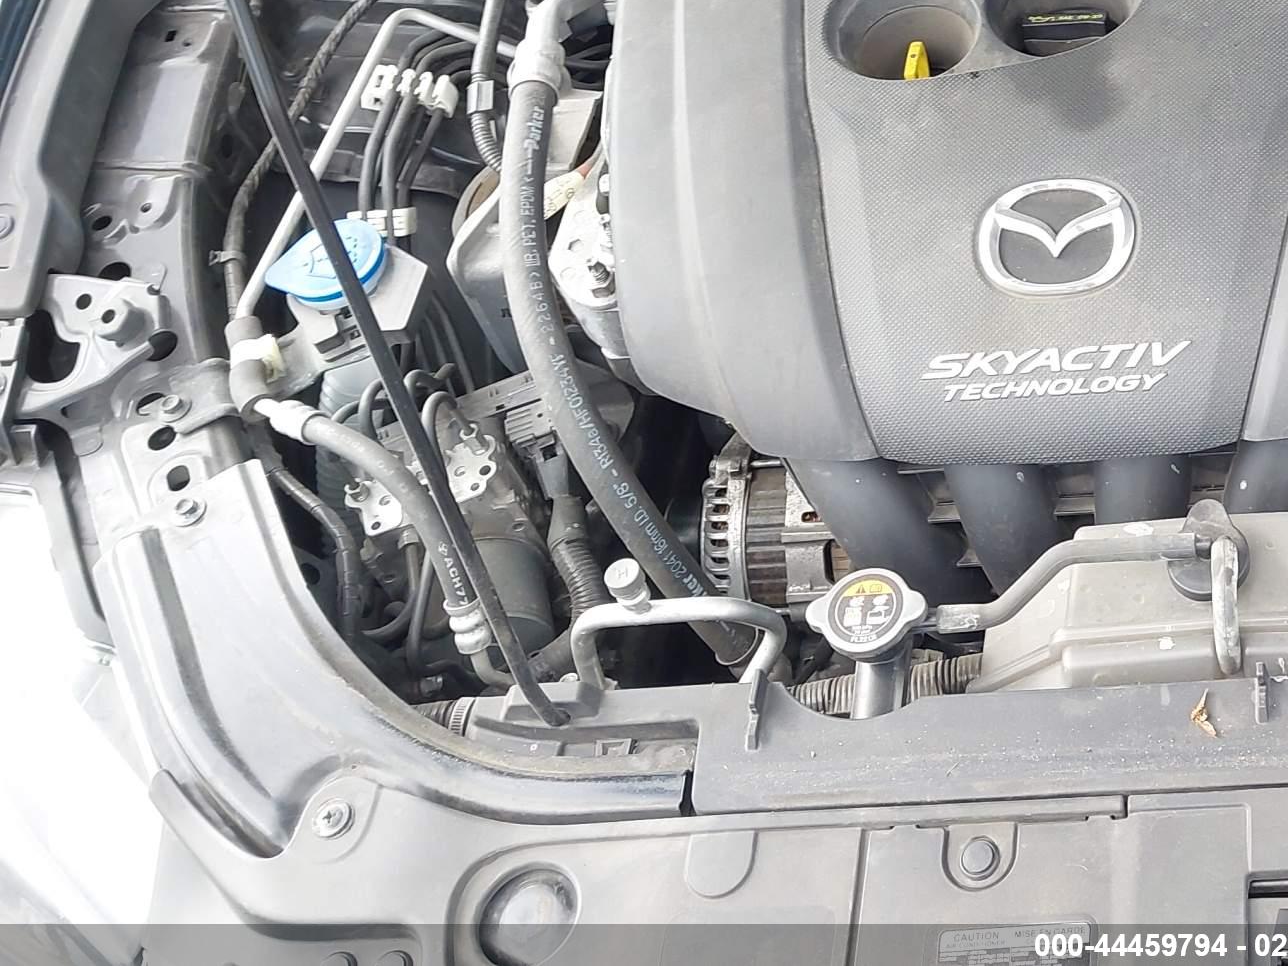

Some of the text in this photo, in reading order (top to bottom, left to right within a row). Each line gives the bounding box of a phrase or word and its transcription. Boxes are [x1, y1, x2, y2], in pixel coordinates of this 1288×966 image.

[523, 105, 545, 150] Parker
[920, 340, 1192, 380] SKYACTIV
[943, 372, 1168, 402] TECHNOLOGY
[645, 522, 669, 555] 16mm
[953, 931, 999, 942] CAUTION
